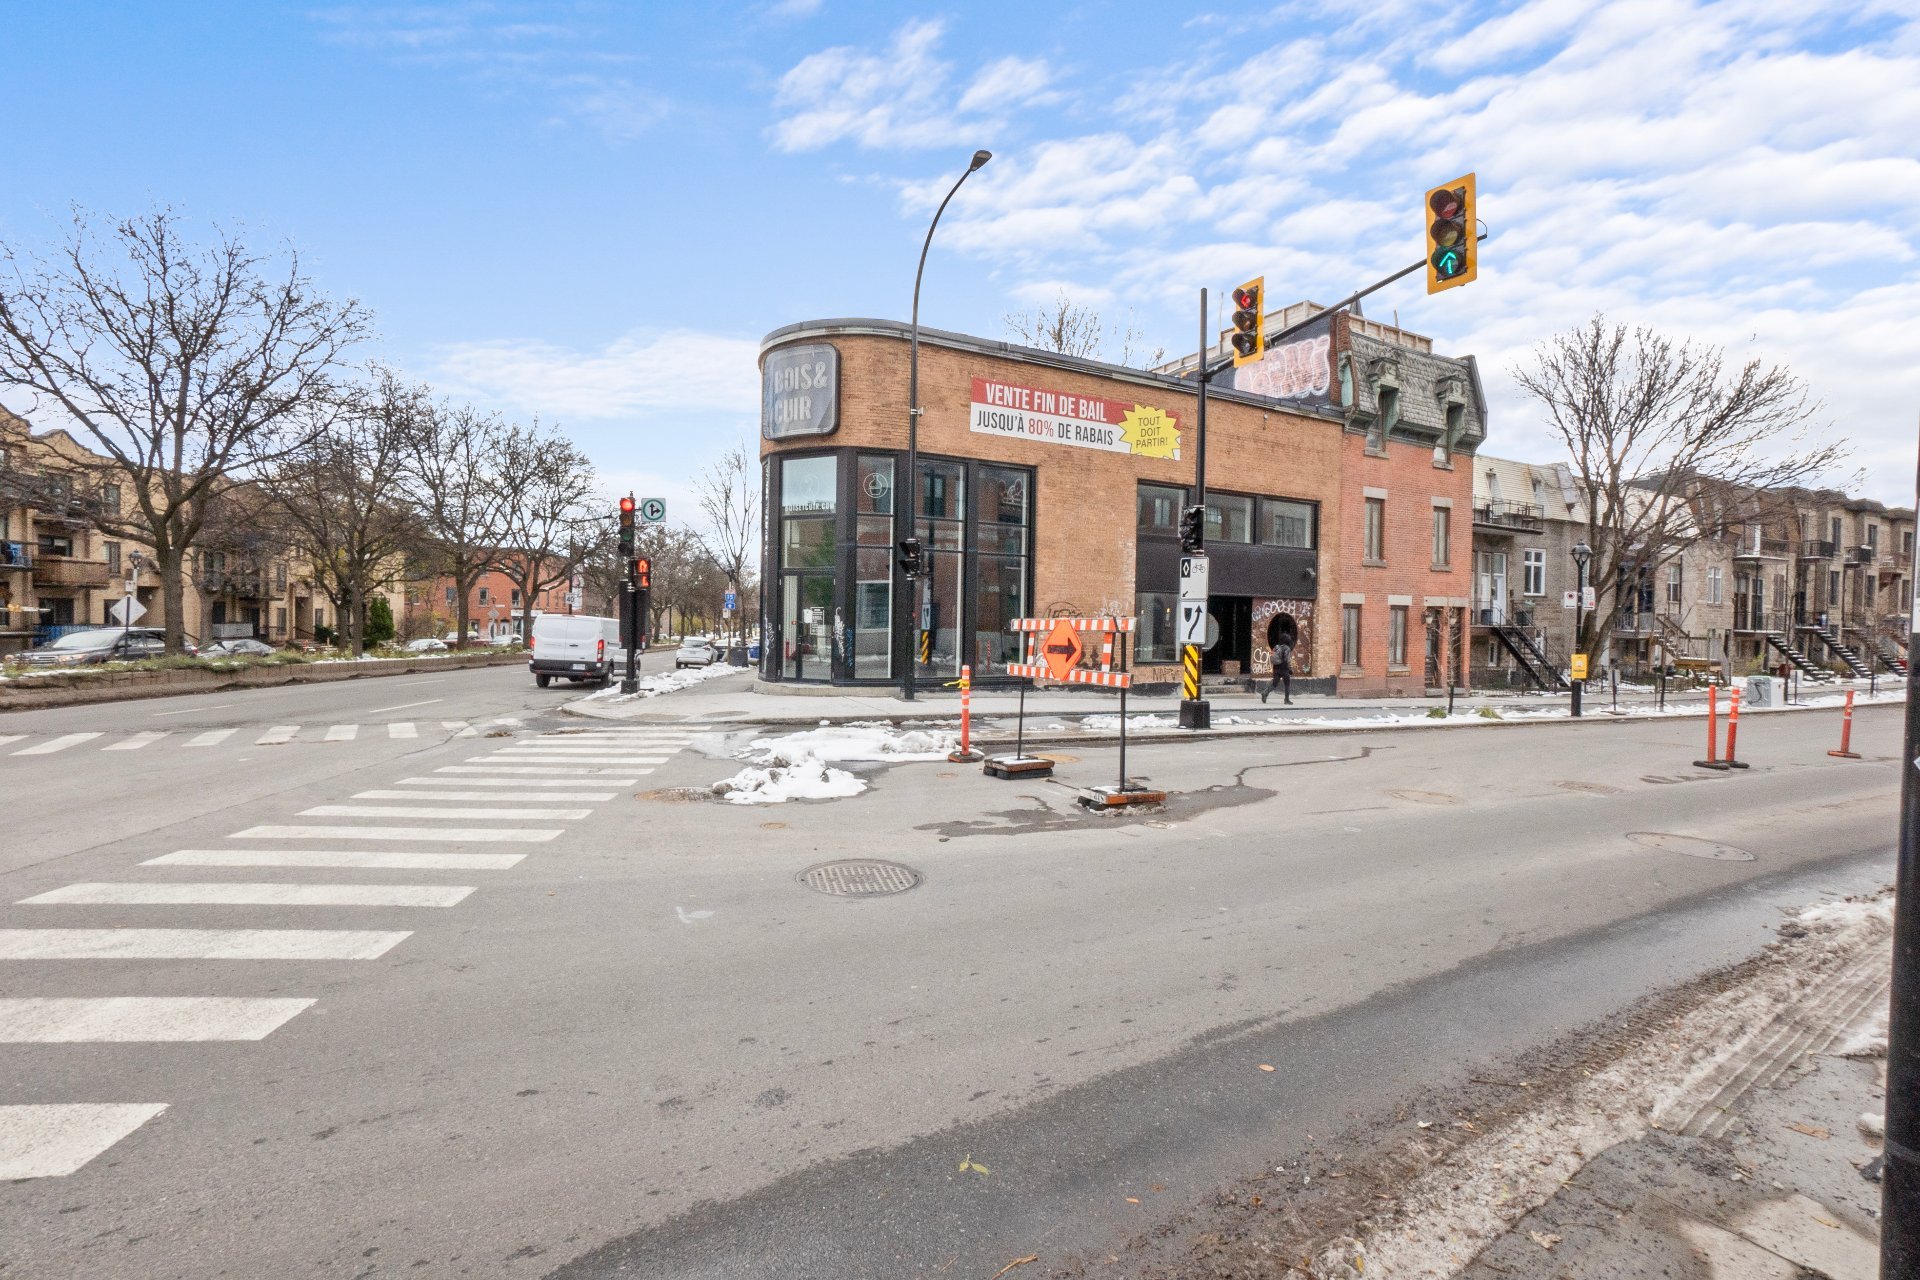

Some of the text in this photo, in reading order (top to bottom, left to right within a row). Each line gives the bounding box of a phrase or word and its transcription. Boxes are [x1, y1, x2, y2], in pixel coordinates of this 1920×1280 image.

[774, 395, 812, 425] CUIR
[985, 382, 1107, 422] VENTE FIN DE BAIL
[977, 410, 1113, 446] JUSQU'À 80% DE RABAIS
[1138, 416, 1161, 427] TOUT
[1140, 426, 1161, 437] DOIT
[1135, 437, 1168, 448] PARTIR!
